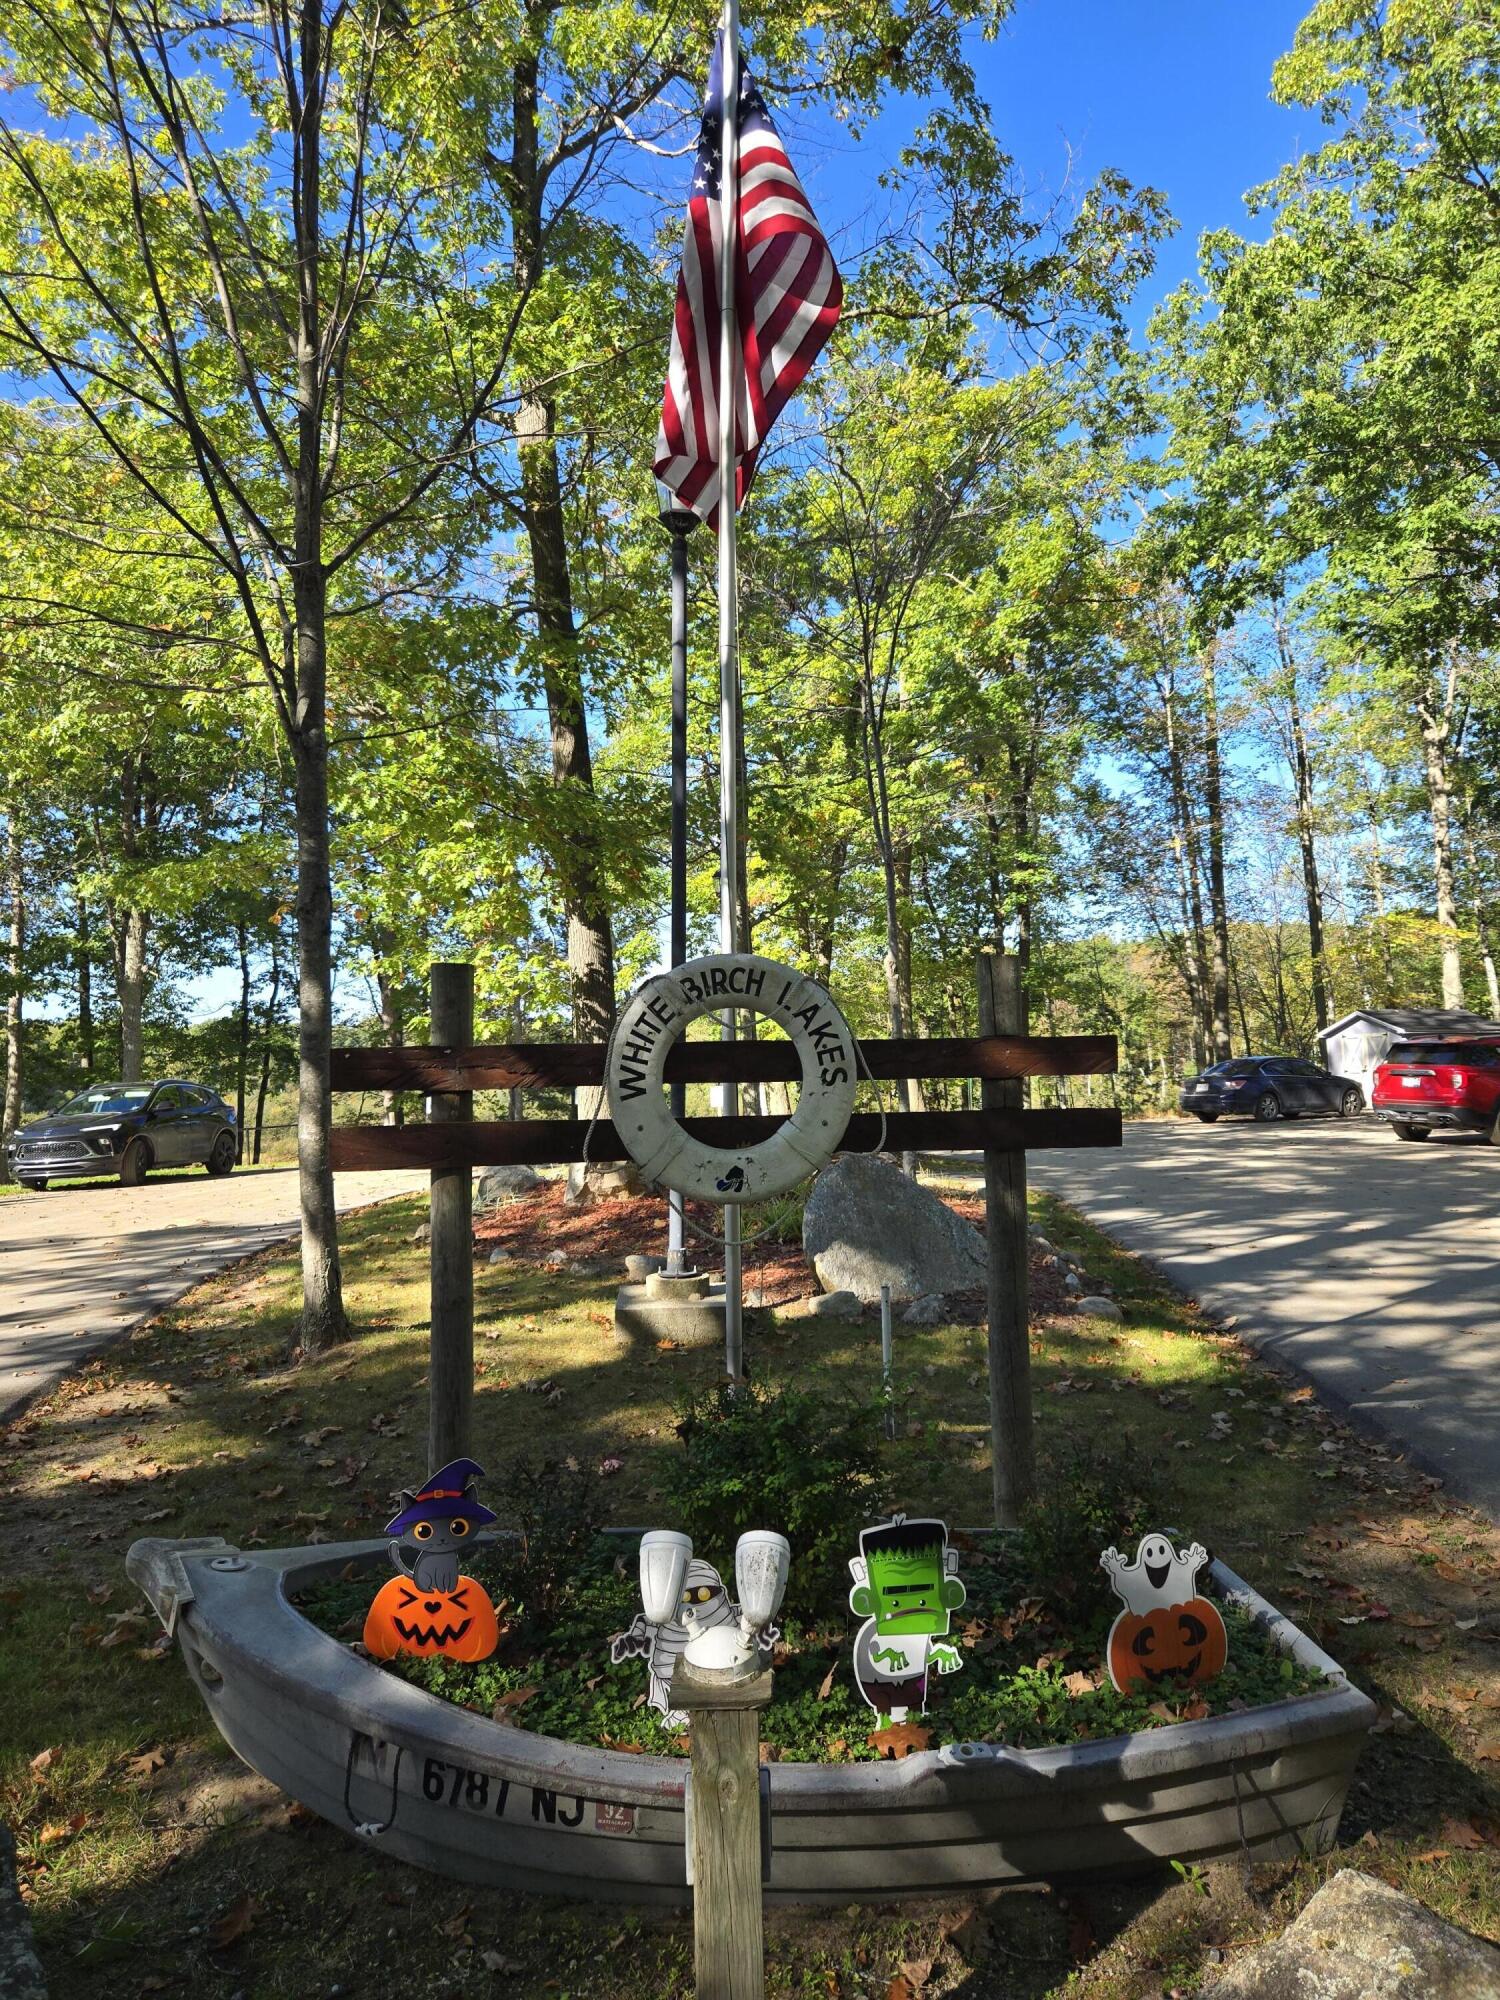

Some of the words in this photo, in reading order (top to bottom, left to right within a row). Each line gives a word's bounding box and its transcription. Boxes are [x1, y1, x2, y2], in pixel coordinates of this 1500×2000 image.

[620, 996, 676, 1101] WHITE
[680, 967, 766, 1005] BIRCH
[777, 981, 848, 1087] LAKES
[531, 1788, 585, 1827] NJ
